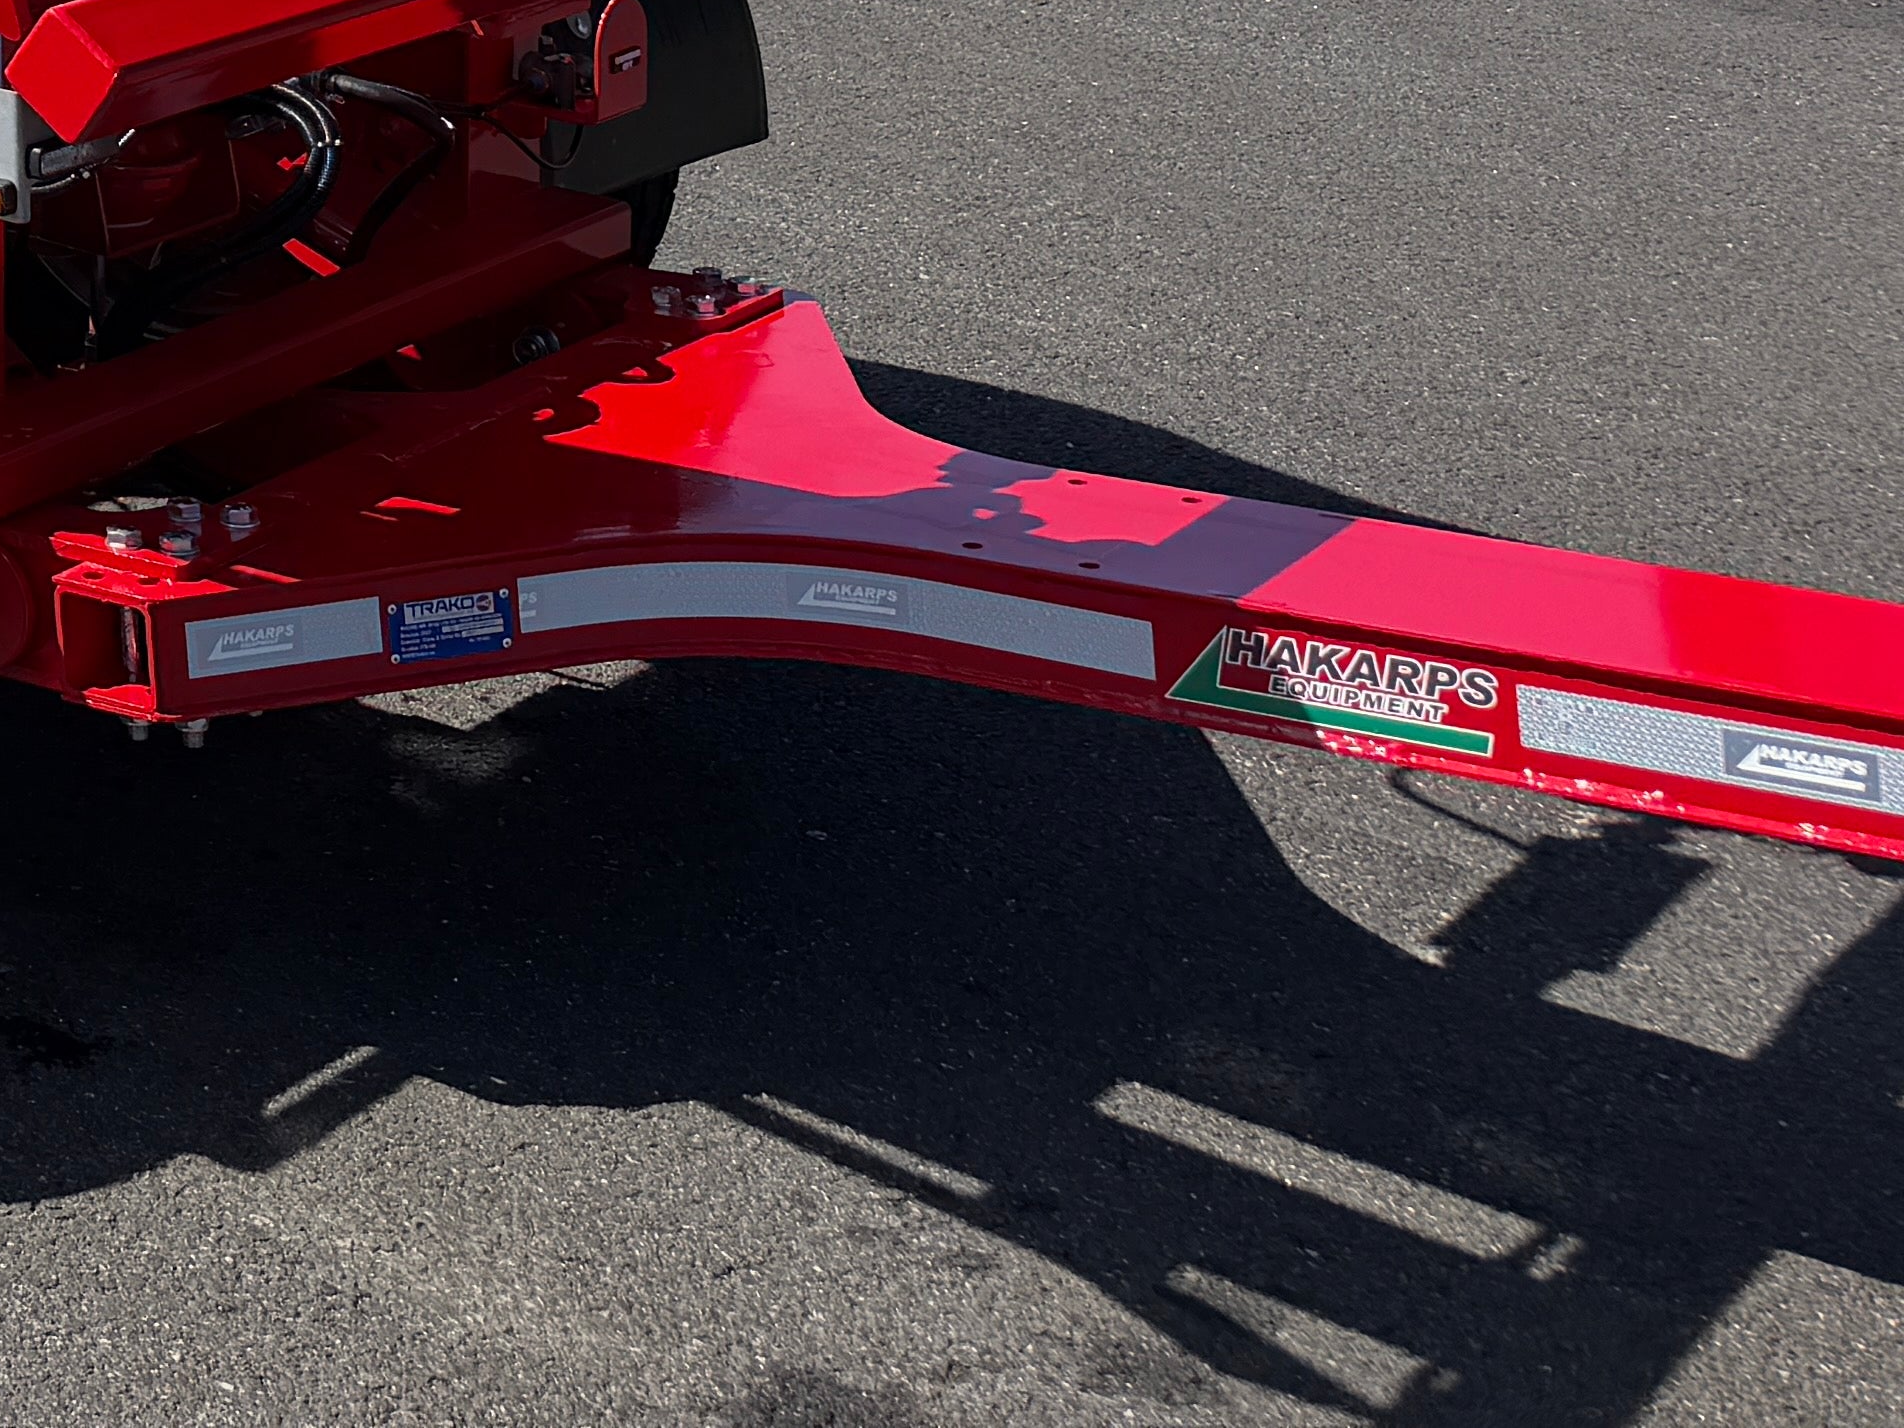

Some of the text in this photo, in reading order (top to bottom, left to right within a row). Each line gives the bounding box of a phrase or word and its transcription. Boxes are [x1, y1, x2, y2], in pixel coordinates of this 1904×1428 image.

[816, 581, 898, 603] HAKARPS
[405, 596, 476, 620] TRAKO
[223, 624, 295, 646] HAKARPS
[1225, 627, 1499, 709] HAKARPS
[1268, 674, 1449, 723] EQUIPMENT
[1759, 743, 1869, 777] HAKARPS
